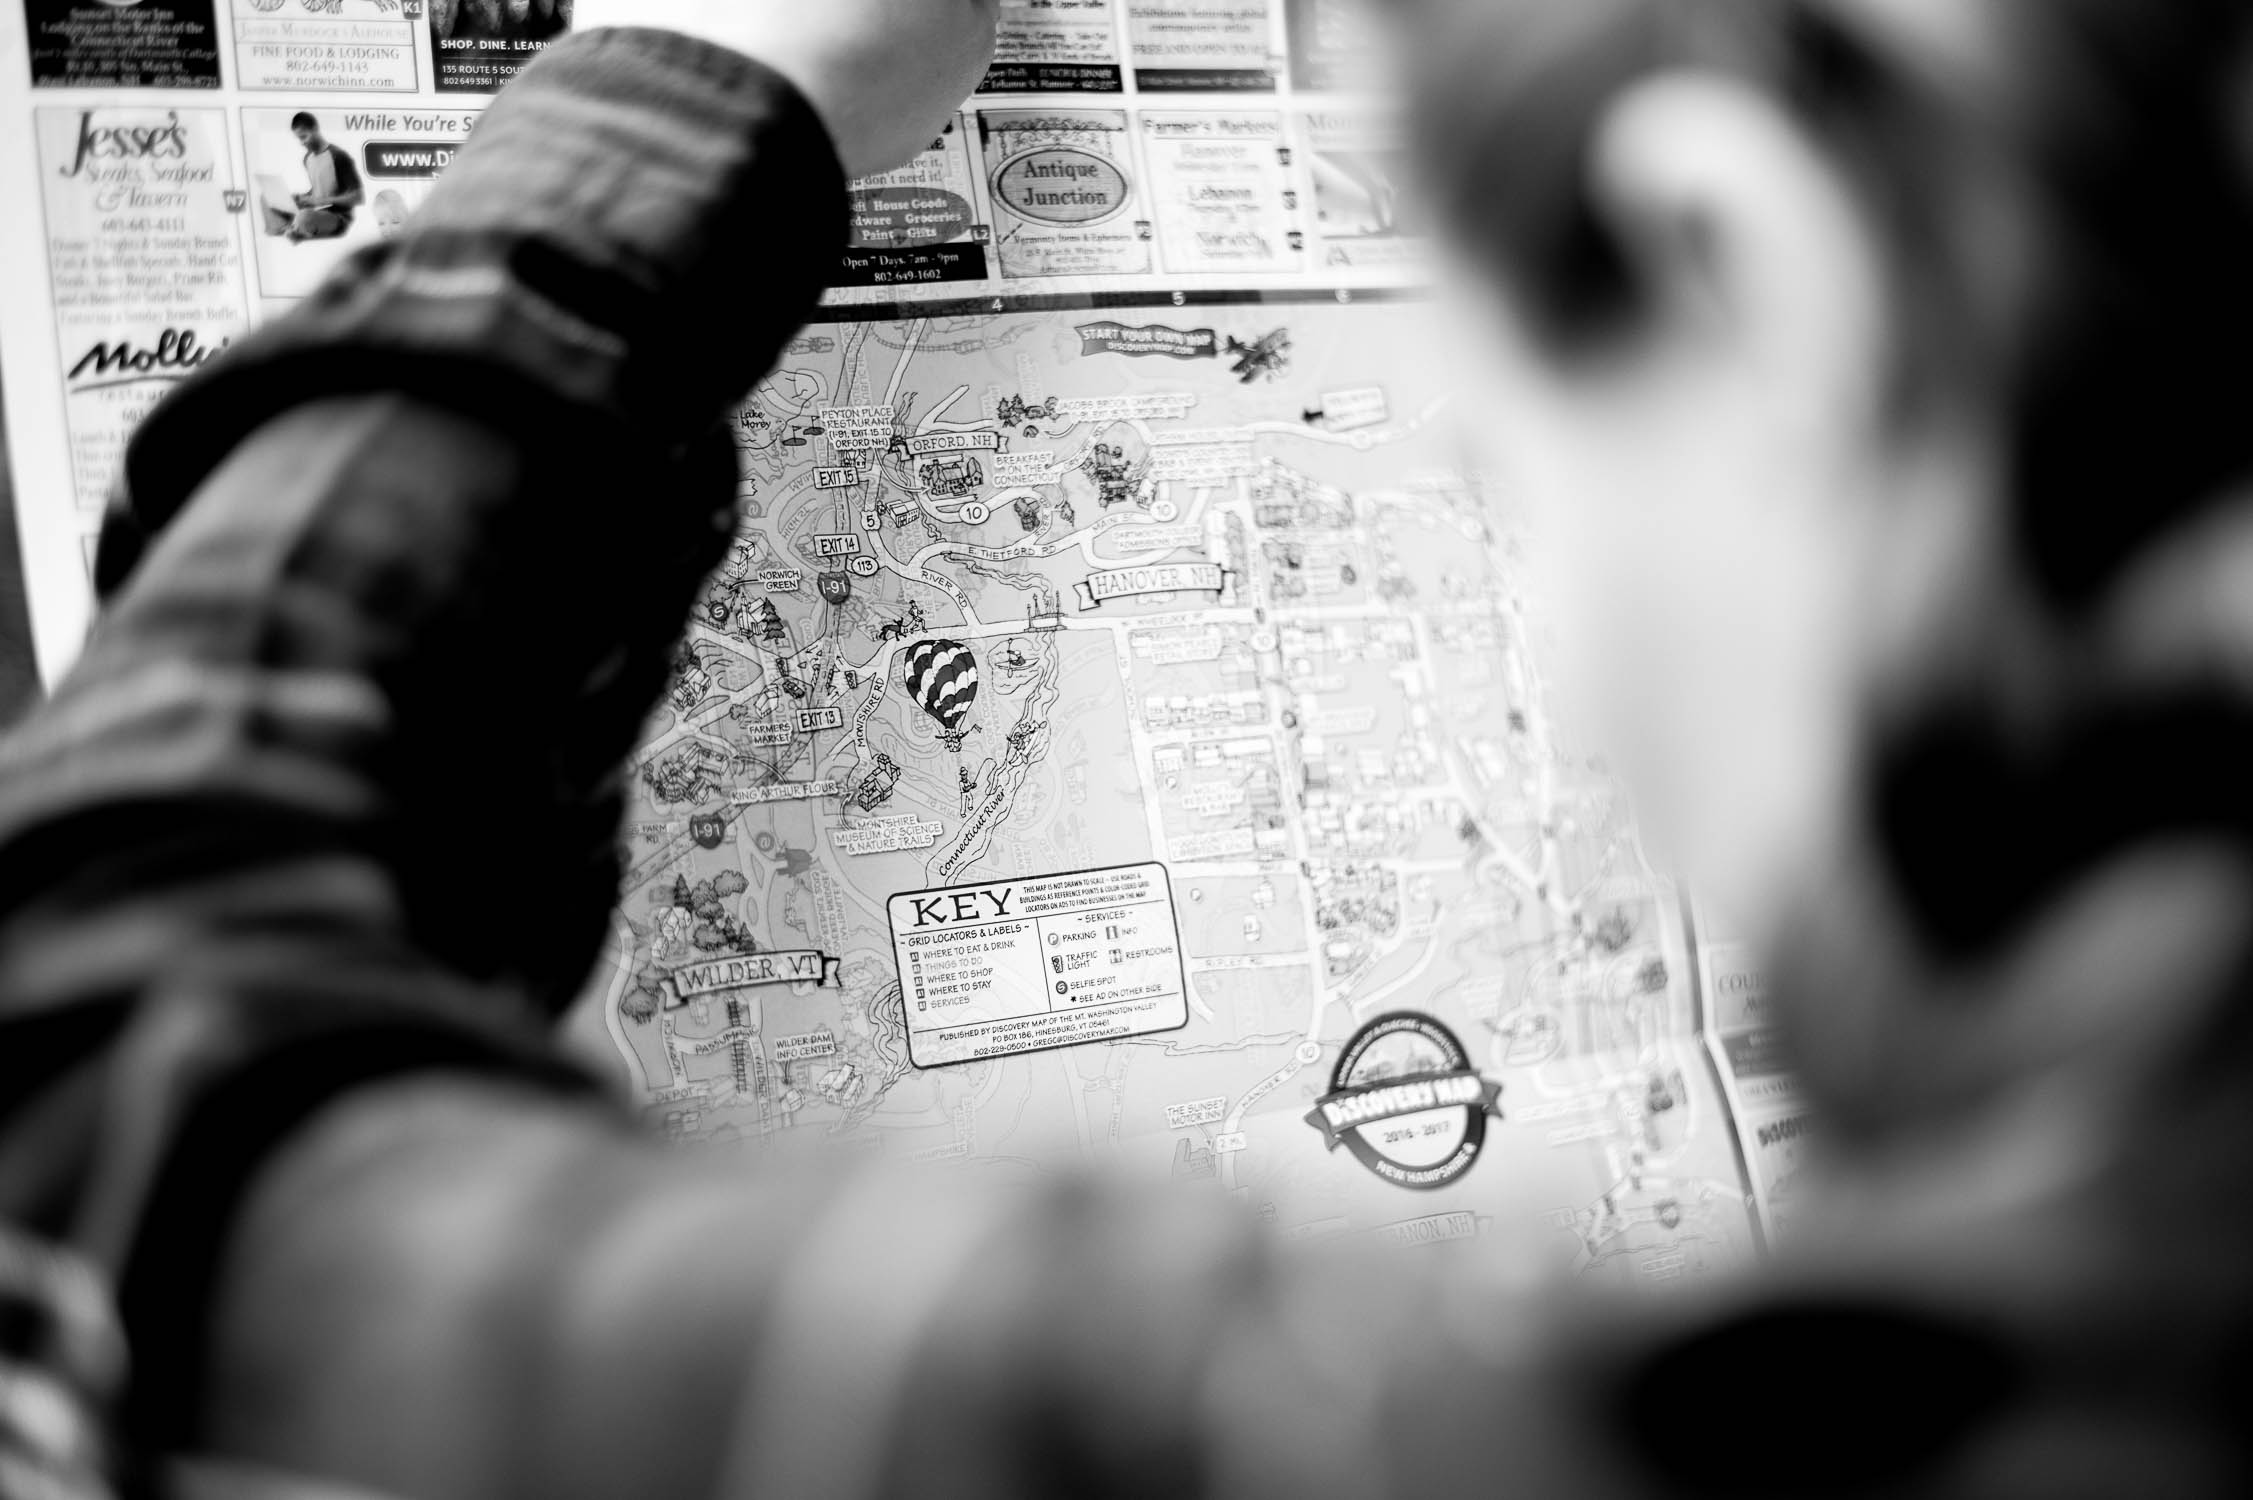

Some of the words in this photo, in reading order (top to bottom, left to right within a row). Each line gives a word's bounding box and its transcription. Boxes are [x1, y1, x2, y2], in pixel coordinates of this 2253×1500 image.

[403, 1, 422, 14] K1
[440, 39, 476, 50] SHOP.
[479, 40, 511, 51] DINE.
[252, 46, 282, 58] FINE
[286, 46, 324, 58] FOOD
[326, 48, 336, 58] &
[339, 48, 400, 60] LODGING
[285, 61, 369, 73] 802-649-1143
[442, 65, 457, 74] 135
[459, 65, 490, 74] ROUTE
[492, 66, 498, 74] 5
[263, 75, 395, 88] www.norwichinn.com
[345, 114, 397, 131] While
[403, 115, 457, 132] You're
[58, 110, 187, 177] Jesse's
[150, 161, 215, 190] Seafood
[865, 173, 897, 186] don't
[899, 171, 926, 184] need
[1023, 160, 1099, 182] Antique
[1023, 187, 1107, 206] Junction
[873, 200, 910, 212] House
[910, 198, 948, 209] Goods
[904, 212, 962, 224] Groceries
[862, 229, 895, 241] Paint
[907, 227, 937, 238] Gifts
[973, 229, 989, 241] L2
[843, 257, 868, 269] Open
[874, 269, 942, 282] 802-649-1602
[992, 298, 1003, 310] 4
[1172, 290, 1186, 305] 5
[1082, 328, 1119, 341] START
[1120, 329, 1154, 342] YOUR
[1154, 331, 1184, 344] OWN
[739, 410, 765, 420] Lake
[821, 409, 860, 419] PEYTON
[861, 407, 893, 418] PLACE
[740, 419, 772, 431] Morey
[827, 417, 891, 429] RESTAURANT
[851, 429, 868, 438] EXIT
[835, 439, 870, 449] ORFORD
[913, 437, 969, 451] ORFORD,
[972, 435, 992, 447] NH
[996, 453, 1053, 465] BREAKFAST
[820, 470, 842, 487] EXIT
[843, 469, 854, 484] 15
[1008, 466, 1028, 475] ON
[993, 473, 1061, 486] CONNECTICUT
[965, 506, 983, 520] 10
[866, 514, 876, 528] 5
[820, 538, 843, 555] EXIT
[844, 537, 856, 551] 14
[981, 547, 1036, 561] THETFORD
[1041, 545, 1057, 556] RD
[856, 559, 873, 572] 113
[759, 570, 800, 581] NORWICH
[921, 570, 953, 591] RIVER
[1190, 567, 1218, 585] NH
[766, 580, 798, 591] GREEN
[821, 580, 847, 595] I-91
[874, 678, 885, 693] RD
[801, 713, 823, 729] EXIT
[824, 711, 836, 724] 13
[856, 692, 880, 748] MONTSHIRE
[749, 723, 791, 734] FARMERS
[753, 734, 790, 744] MARKET
[732, 789, 758, 801] KING
[760, 785, 801, 798] ARTHUR
[803, 782, 836, 794] FLOUR
[984, 788, 1006, 818] River
[857, 816, 917, 829] MONTSHIRE
[694, 823, 720, 839] I-91
[836, 830, 881, 843] MUSEUM
[882, 829, 897, 838] OF
[899, 823, 941, 836] SCIENCE
[858, 839, 896, 850] NATURE
[899, 835, 933, 846] TRAILS
[939, 813, 987, 876] Connecticut
[1023, 886, 1036, 894] THIS
[1064, 880, 1083, 889] DRAWN
[1019, 895, 1047, 904] BUILDINGS
[1054, 890, 1081, 899] REFERENCE
[1081, 887, 1099, 895] POINTS
[910, 888, 1012, 927] KEY
[1025, 904, 1050, 913] LOCATORS
[1088, 895, 1118, 904] BUSINESSES
[1085, 910, 1126, 923] SERVICES
[908, 936, 931, 947] GRID
[932, 930, 978, 944] LOCATORS
[979, 928, 987, 937] &
[988, 923, 1022, 936] LABELS
[1062, 930, 1097, 943] PARKING
[923, 949, 952, 960] WHERE
[953, 946, 965, 955] TO
[967, 944, 981, 954] EAT
[991, 939, 1016, 951] DRINK
[1066, 950, 1099, 962] TRAFFIC
[1125, 945, 1173, 960] RESTROOMS
[681, 959, 783, 989] WILDER,
[787, 954, 818, 975] VT
[925, 960, 957, 972] THINGS
[1067, 960, 1091, 971] LIGHT
[927, 973, 956, 984] WHERE
[958, 970, 969, 980] TO
[970, 967, 994, 978] SHOP
[1070, 978, 1096, 990] SELFIE
[1097, 975, 1117, 986] SPOT
[929, 985, 958, 996] WHERE
[960, 982, 970, 992] TO
[972, 980, 992, 991] STAY
[1079, 994, 1093, 1003] SEE
[1095, 992, 1107, 1001] AD
[1108, 990, 1119, 999] ON
[1120, 986, 1143, 998] OTHER
[1145, 983, 1162, 993] SIDE
[931, 995, 970, 1009] SERVICES
[939, 1029, 979, 1041] PUBLISHED
[980, 1027, 990, 1035] BY
[991, 1022, 1030, 1034] DISCOVERY
[1031, 1019, 1047, 1028] MAP
[1049, 1017, 1058, 1025] OF
[1060, 1015, 1073, 1024] THE
[1087, 1007, 1133, 1020] WASHINGTON
[1134, 1002, 1158, 1012] VALLEY
[1003, 1033, 1018, 1042] BOX
[1035, 1025, 1078, 1037] HINESBURG,
[1088, 1020, 1110, 1029] 05461
[776, 1038, 809, 1049] WILDER
[810, 1034, 831, 1044] DAM
[776, 1048, 798, 1059] INFO
[800, 1044, 834, 1055] CENTER
[655, 1087, 694, 1101] DEPOT
[1241, 1077, 1281, 1108] HANOVER
[1167, 1105, 1184, 1116] THE
[1187, 1099, 1224, 1113] SUNSET
[1172, 1114, 1199, 1126] MOTOR
[1383, 1128, 1414, 1143] 2016
[1375, 1160, 1404, 1182] NEW
[1406, 1150, 1472, 1184] HAMPSHIRE
